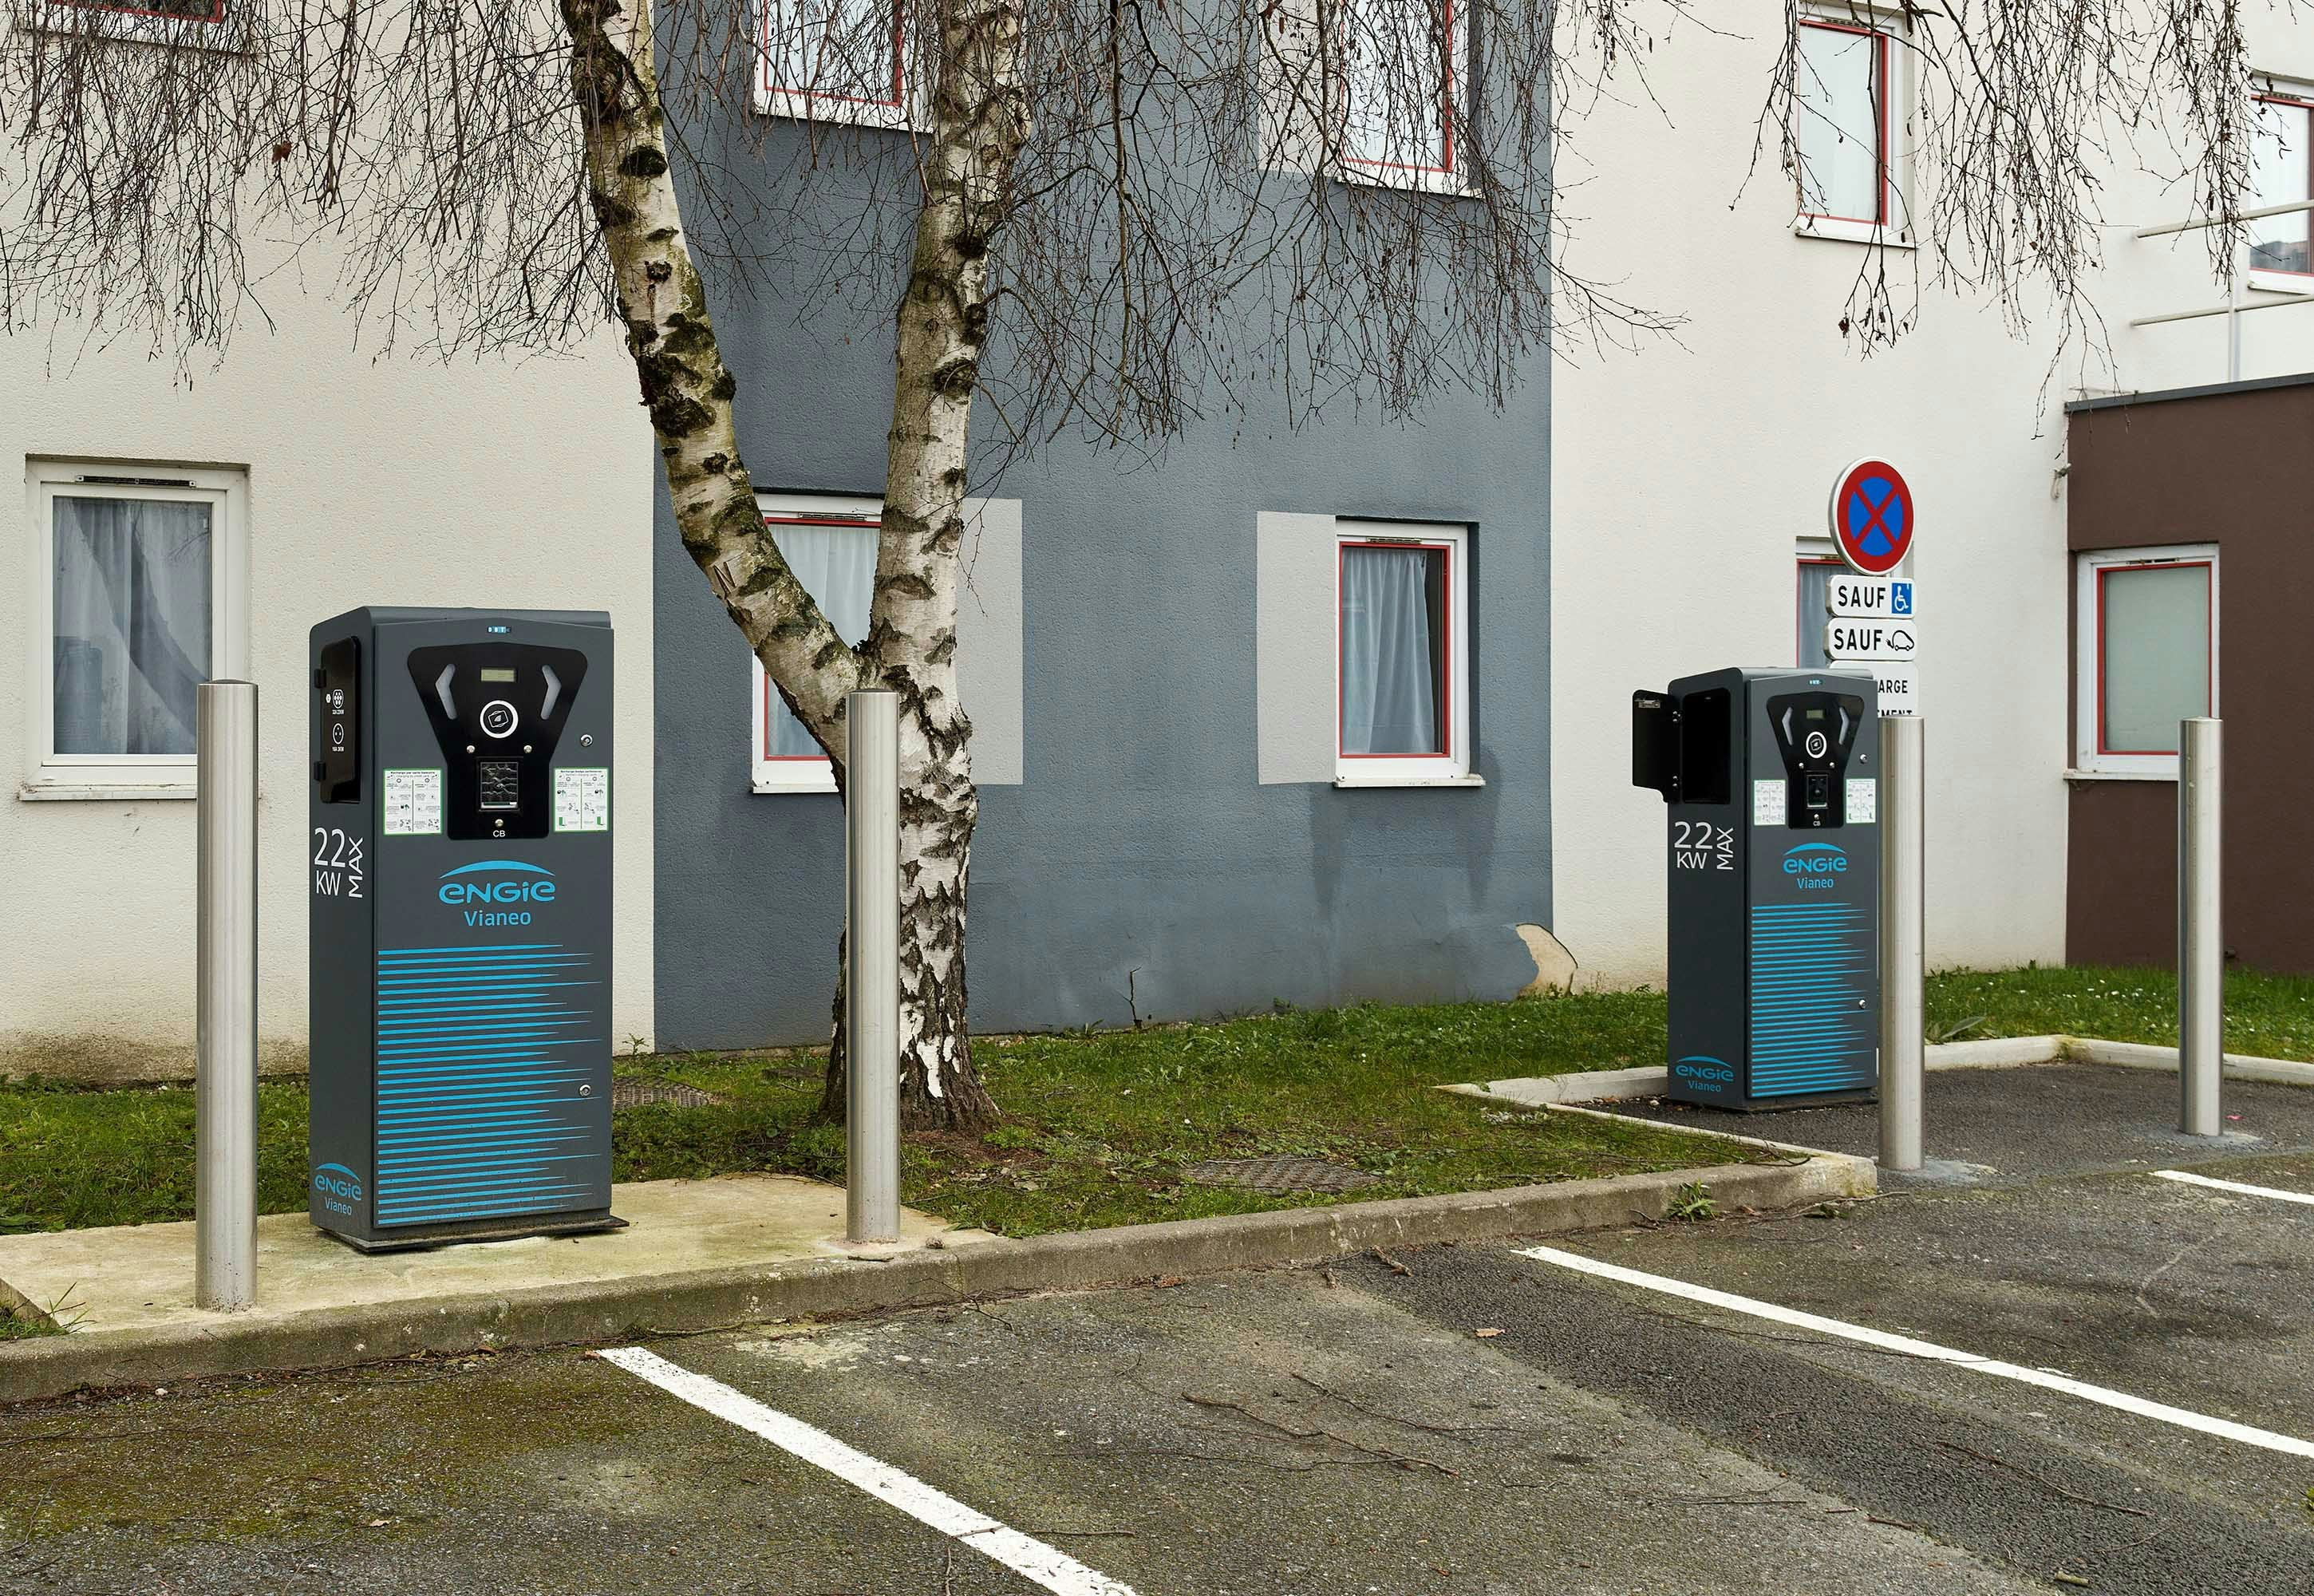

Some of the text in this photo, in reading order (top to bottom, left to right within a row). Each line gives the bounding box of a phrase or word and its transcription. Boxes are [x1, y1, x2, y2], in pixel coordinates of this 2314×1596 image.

[1838, 585, 1886, 608] SAUF
[1834, 628, 1882, 650] SAUF
[1674, 821, 1712, 850] 22
[314, 827, 346, 867] 22
[1716, 827, 1733, 870] MAX
[348, 836, 363, 899] MAX
[1676, 851, 1708, 869] KW
[316, 870, 342, 896] KW
[1796, 877, 1834, 889] Vianeo
[464, 910, 531, 926] Vianeo
[1688, 1080, 1722, 1092] Vianeo
[325, 1196, 352, 1215] Vianeo
